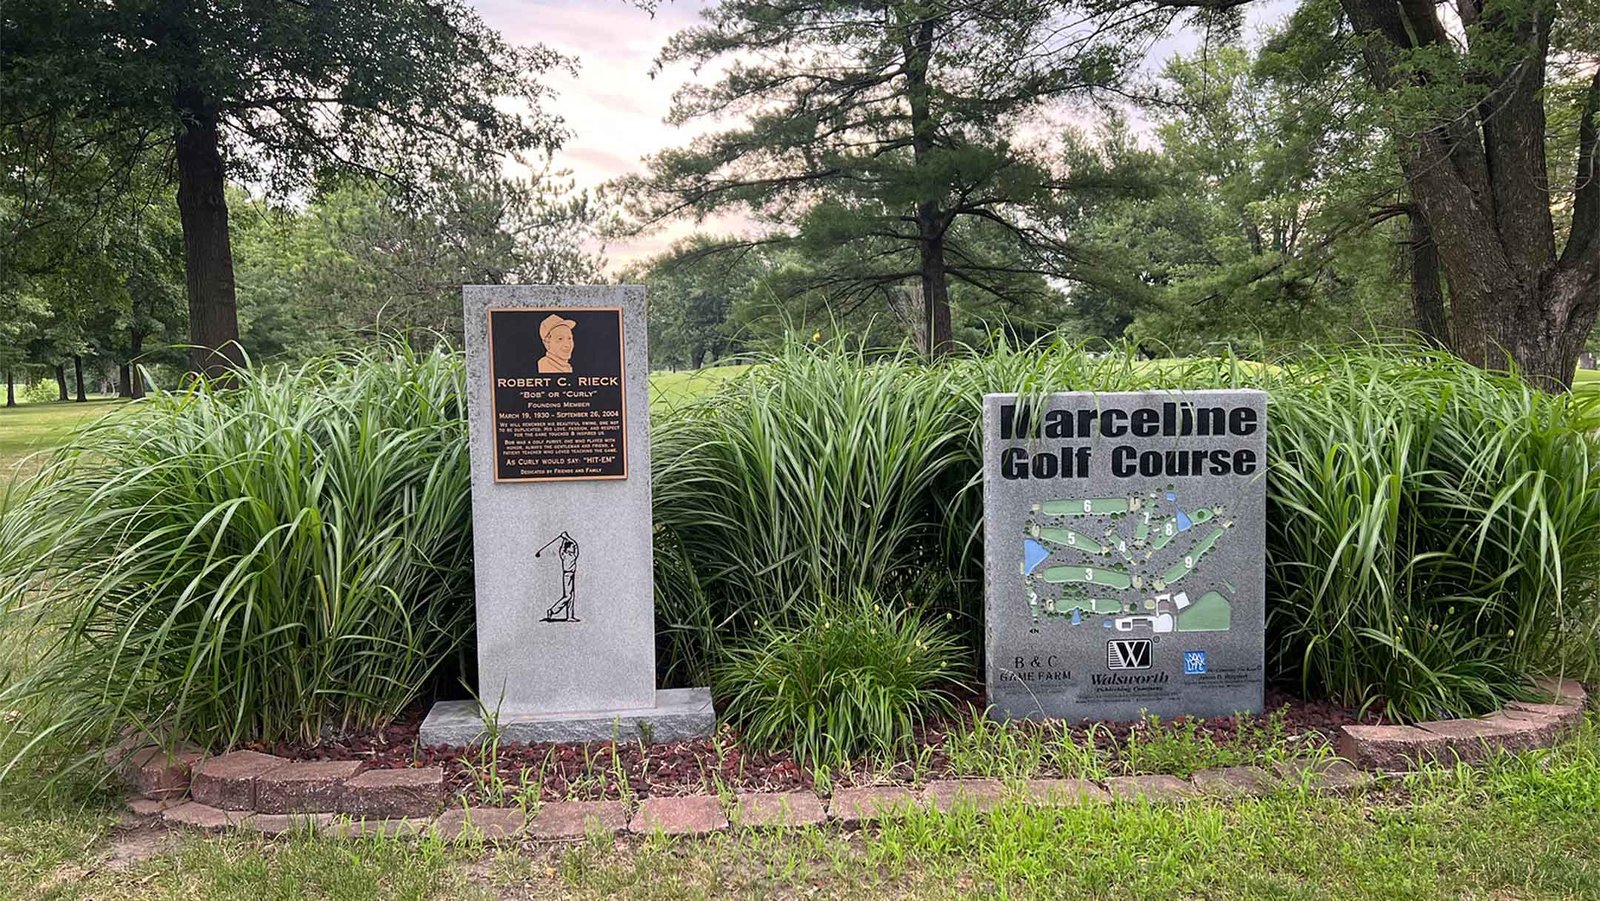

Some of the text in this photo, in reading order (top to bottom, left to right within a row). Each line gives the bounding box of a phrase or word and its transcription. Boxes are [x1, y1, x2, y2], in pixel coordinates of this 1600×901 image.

[498, 377, 618, 387] ROBERT C. RIECK
[1000, 402, 1258, 439] Marceline
[1001, 445, 1257, 480] Golf Course
[1084, 500, 1092, 512] 6
[1144, 512, 1150, 524] 7
[1165, 525, 1172, 536] 8
[1068, 532, 1076, 545] 5
[1118, 540, 1126, 552] 4
[1185, 556, 1193, 568] 9
[1084, 568, 1093, 581] 3
[1030, 592, 1038, 605] 2
[1090, 599, 1096, 611] 1
[1014, 655, 1058, 668] B & C
[1000, 670, 1071, 682] GAME FARM
[1092, 672, 1168, 685] Walsworth
